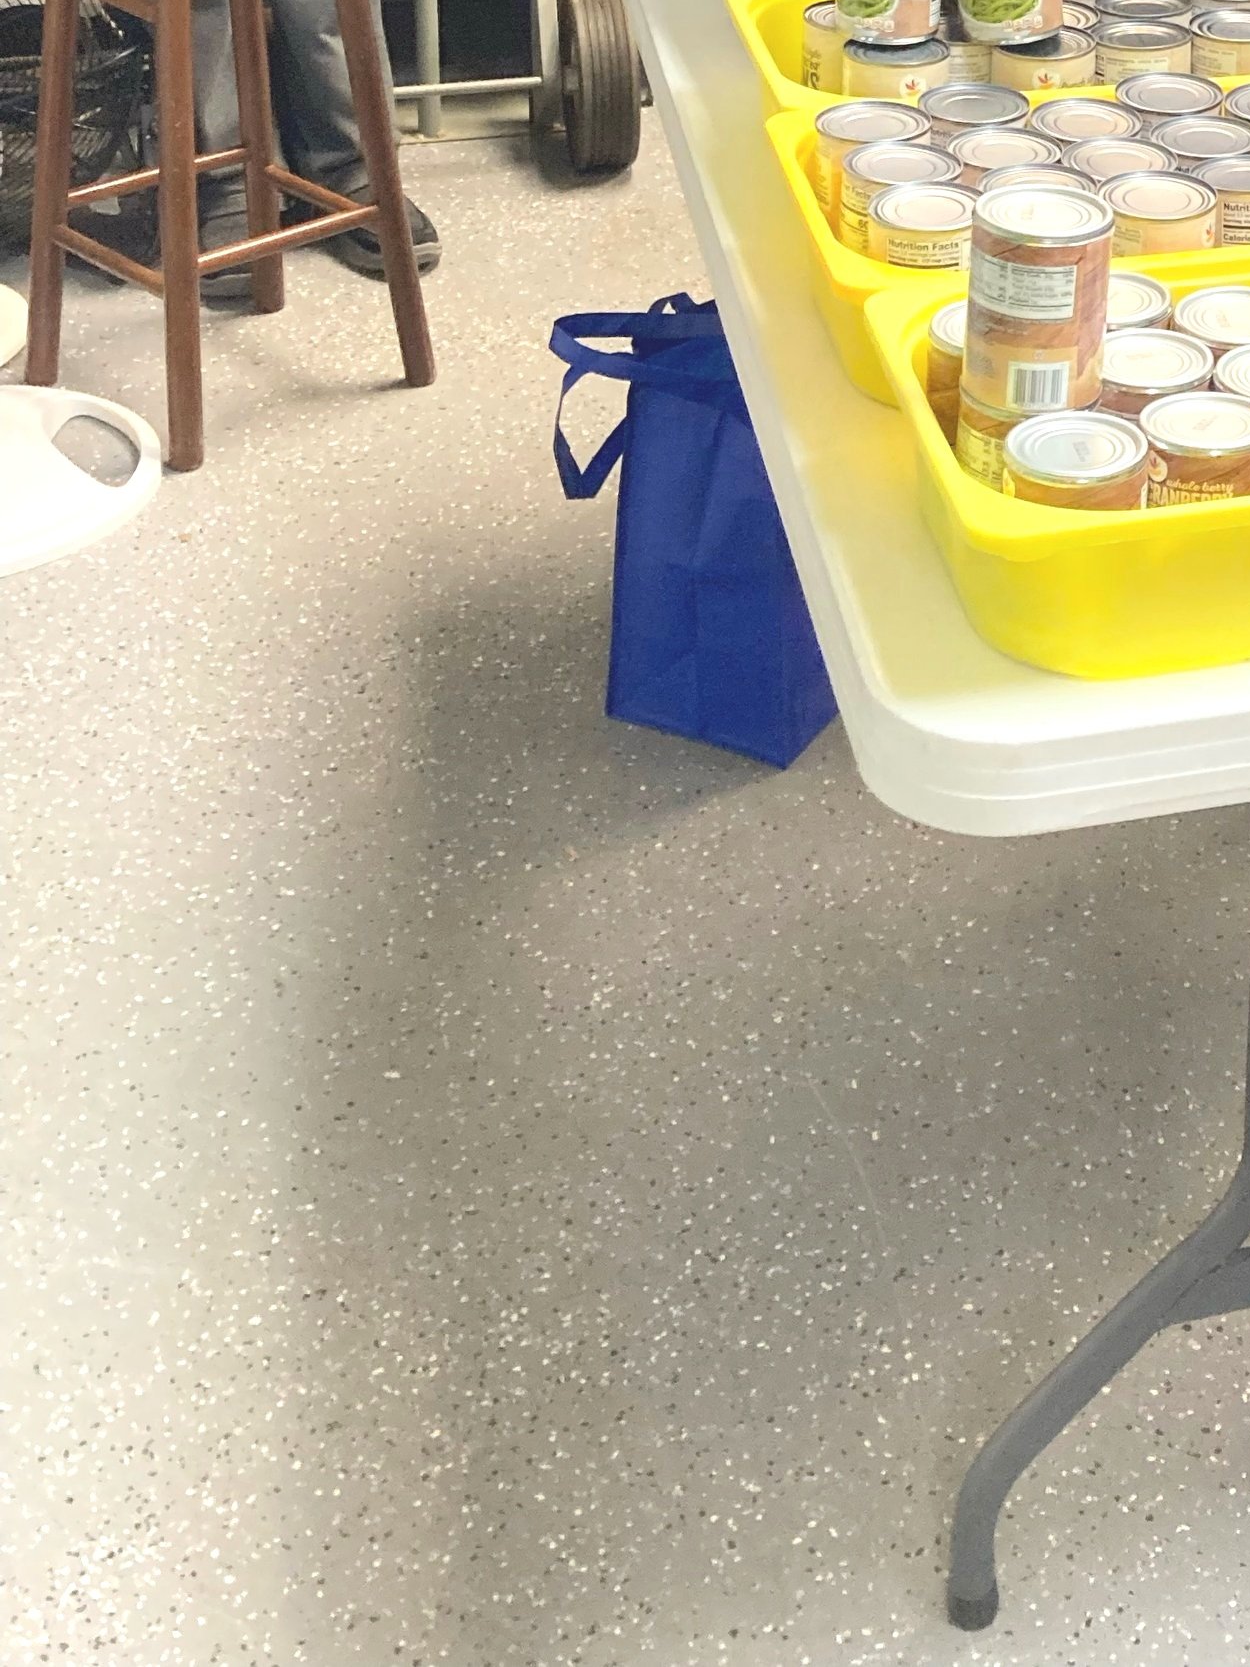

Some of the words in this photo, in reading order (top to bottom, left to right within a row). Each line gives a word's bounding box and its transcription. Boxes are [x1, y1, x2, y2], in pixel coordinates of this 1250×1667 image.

[888, 238, 929, 251] Nutrition
[932, 241, 959, 251] Facts
[1166, 478, 1201, 492] whole
[1202, 482, 1234, 495] berry
